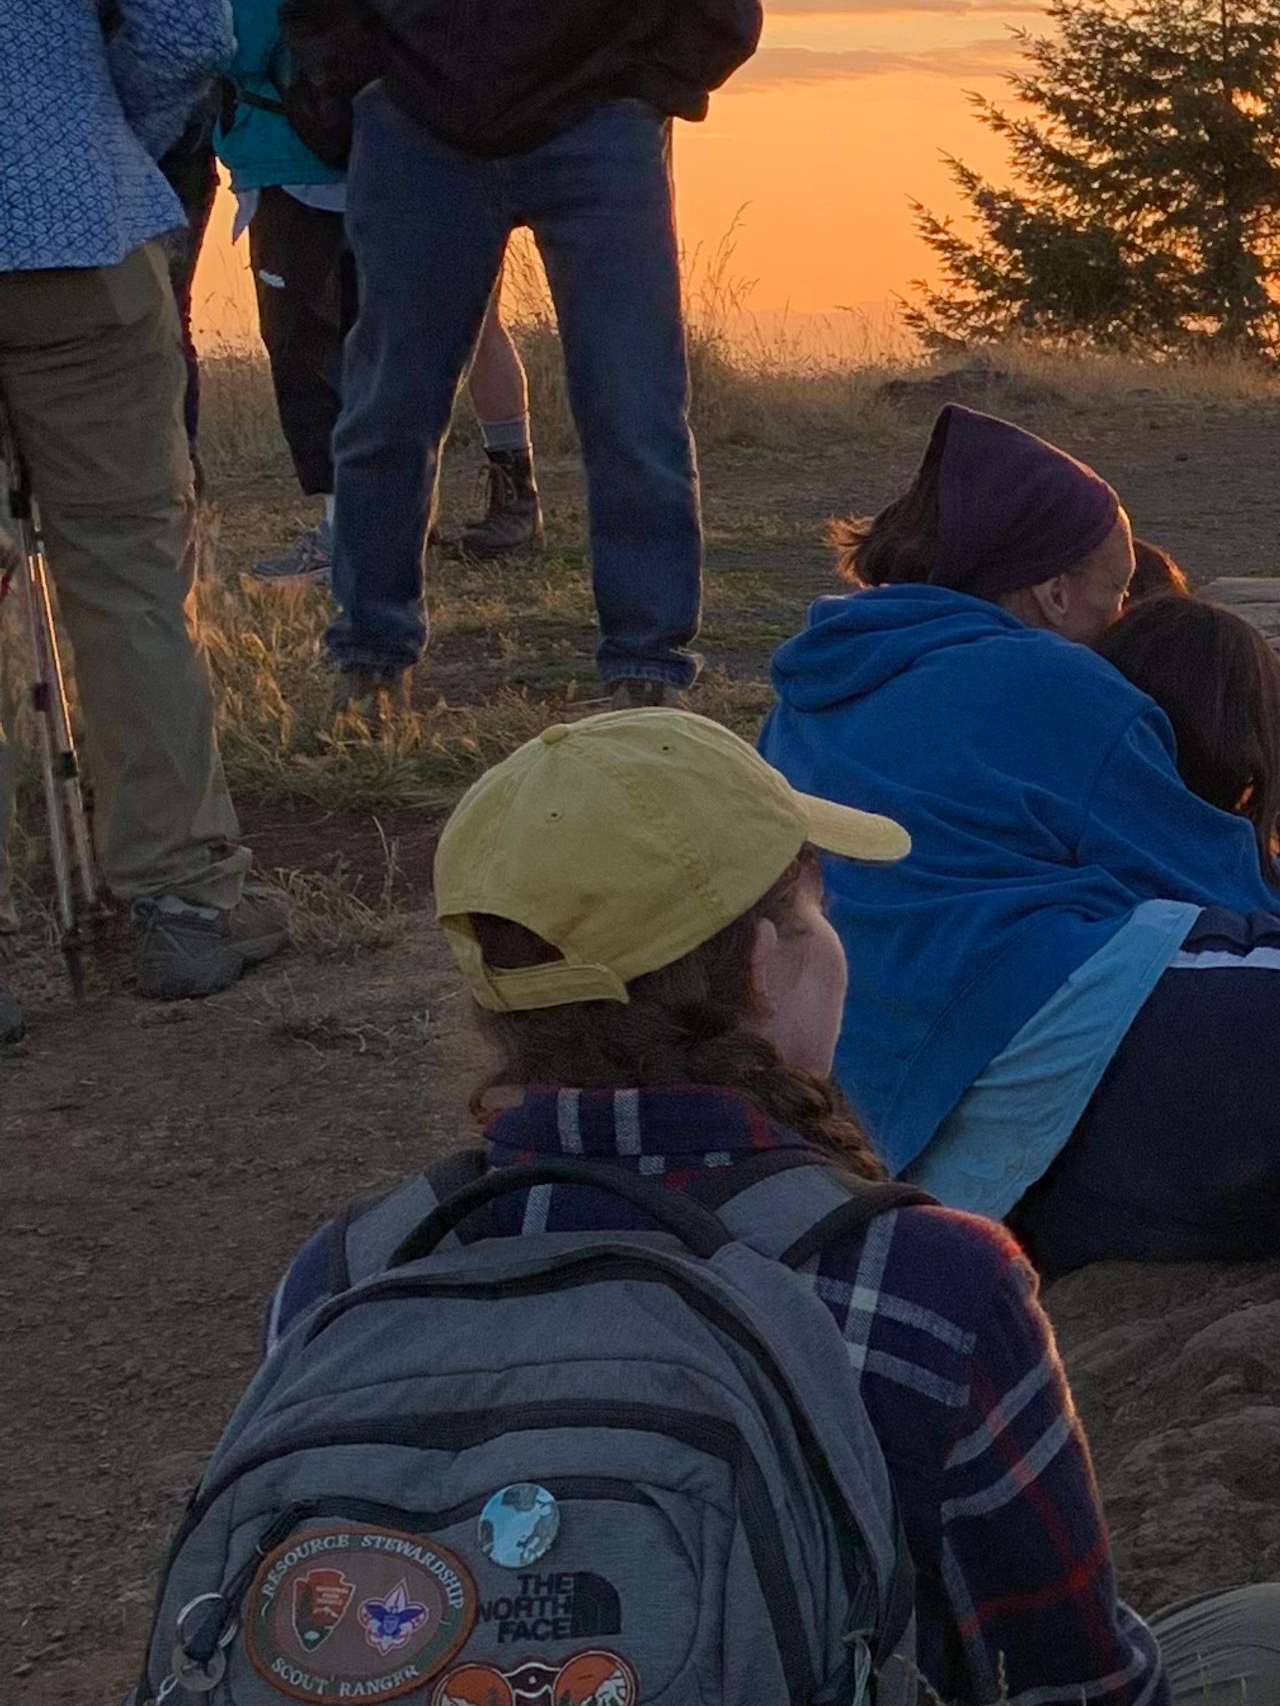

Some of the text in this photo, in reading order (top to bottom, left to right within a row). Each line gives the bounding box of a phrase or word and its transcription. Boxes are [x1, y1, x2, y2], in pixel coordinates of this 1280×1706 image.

[261, 1533, 465, 1609] RESOURCE STEWARDSHIP
[514, 1571, 575, 1594] THE
[478, 1595, 574, 1621] NORTH
[496, 1616, 572, 1643] FACE
[271, 1657, 420, 1697] SCOUT RANGER
